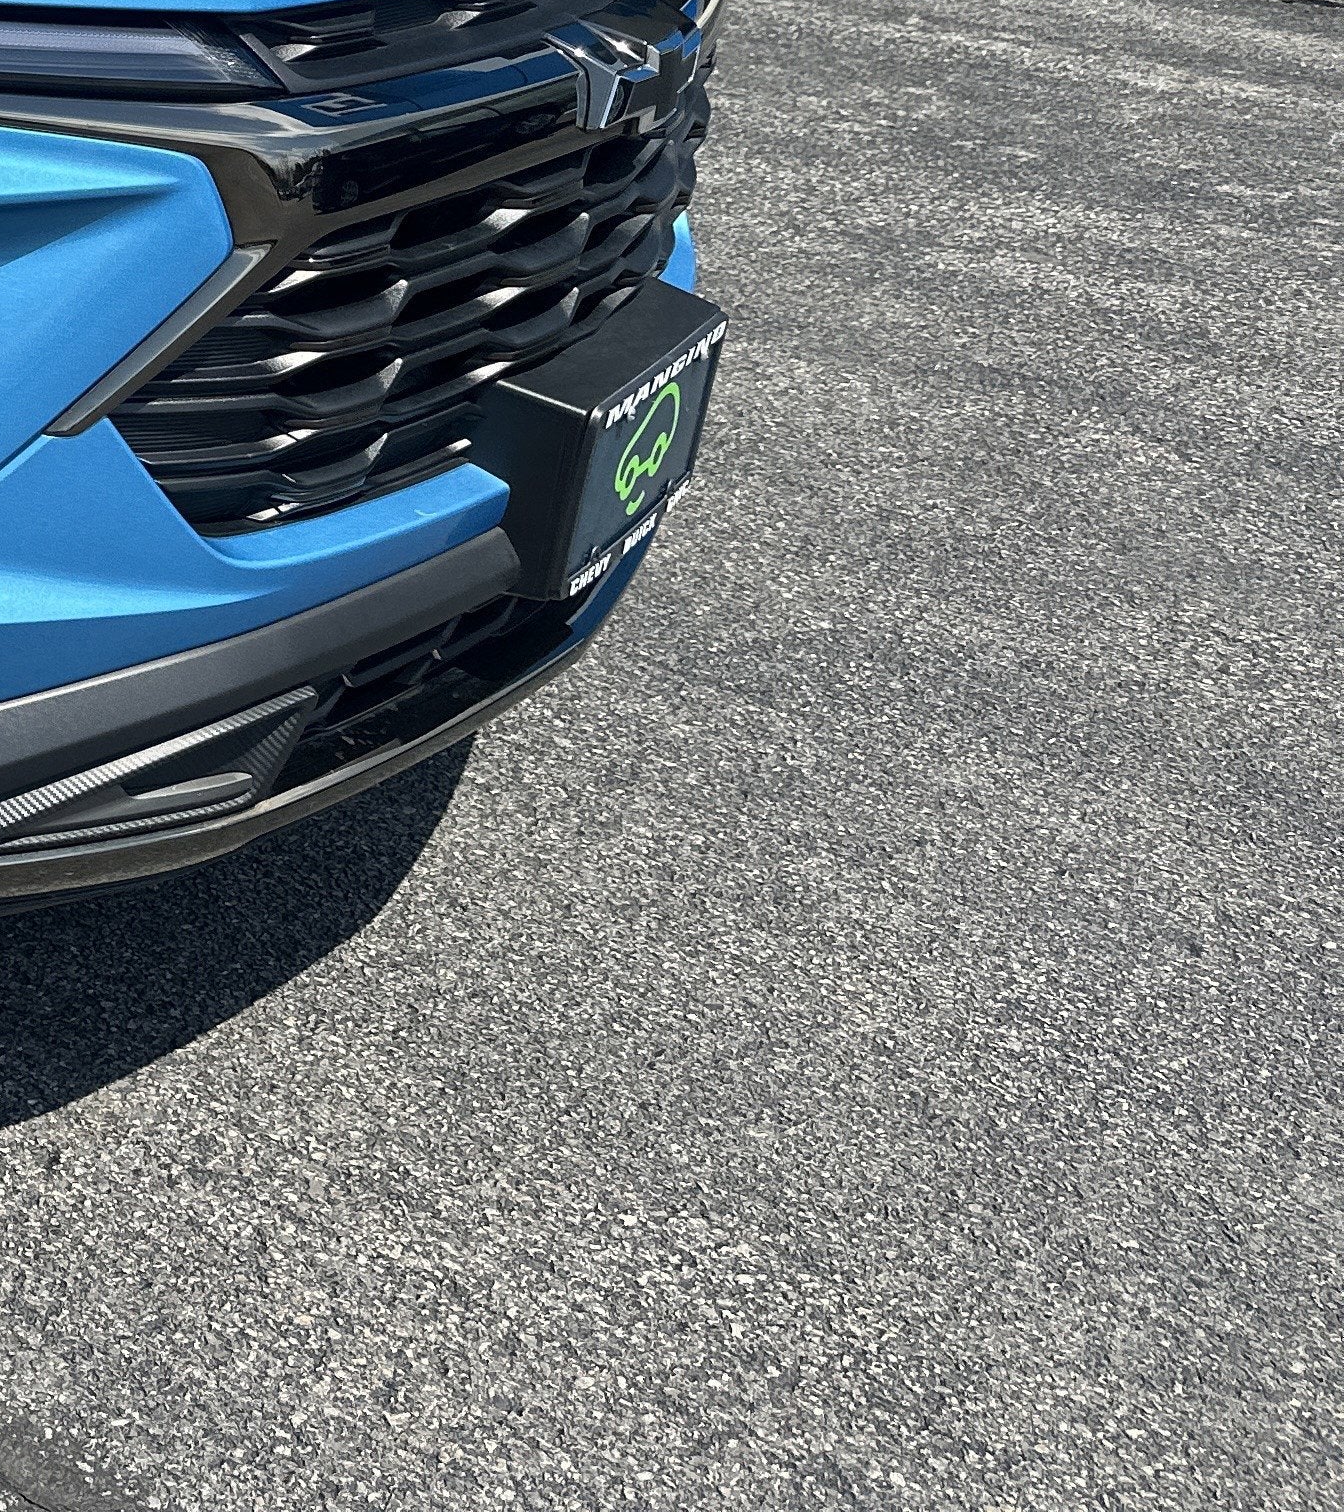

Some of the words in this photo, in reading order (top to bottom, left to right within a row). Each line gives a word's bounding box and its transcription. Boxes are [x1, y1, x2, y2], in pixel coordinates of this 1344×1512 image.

[605, 320, 726, 429] MANGINO
[569, 553, 612, 597] CHEVY
[622, 512, 658, 555] BUICK
